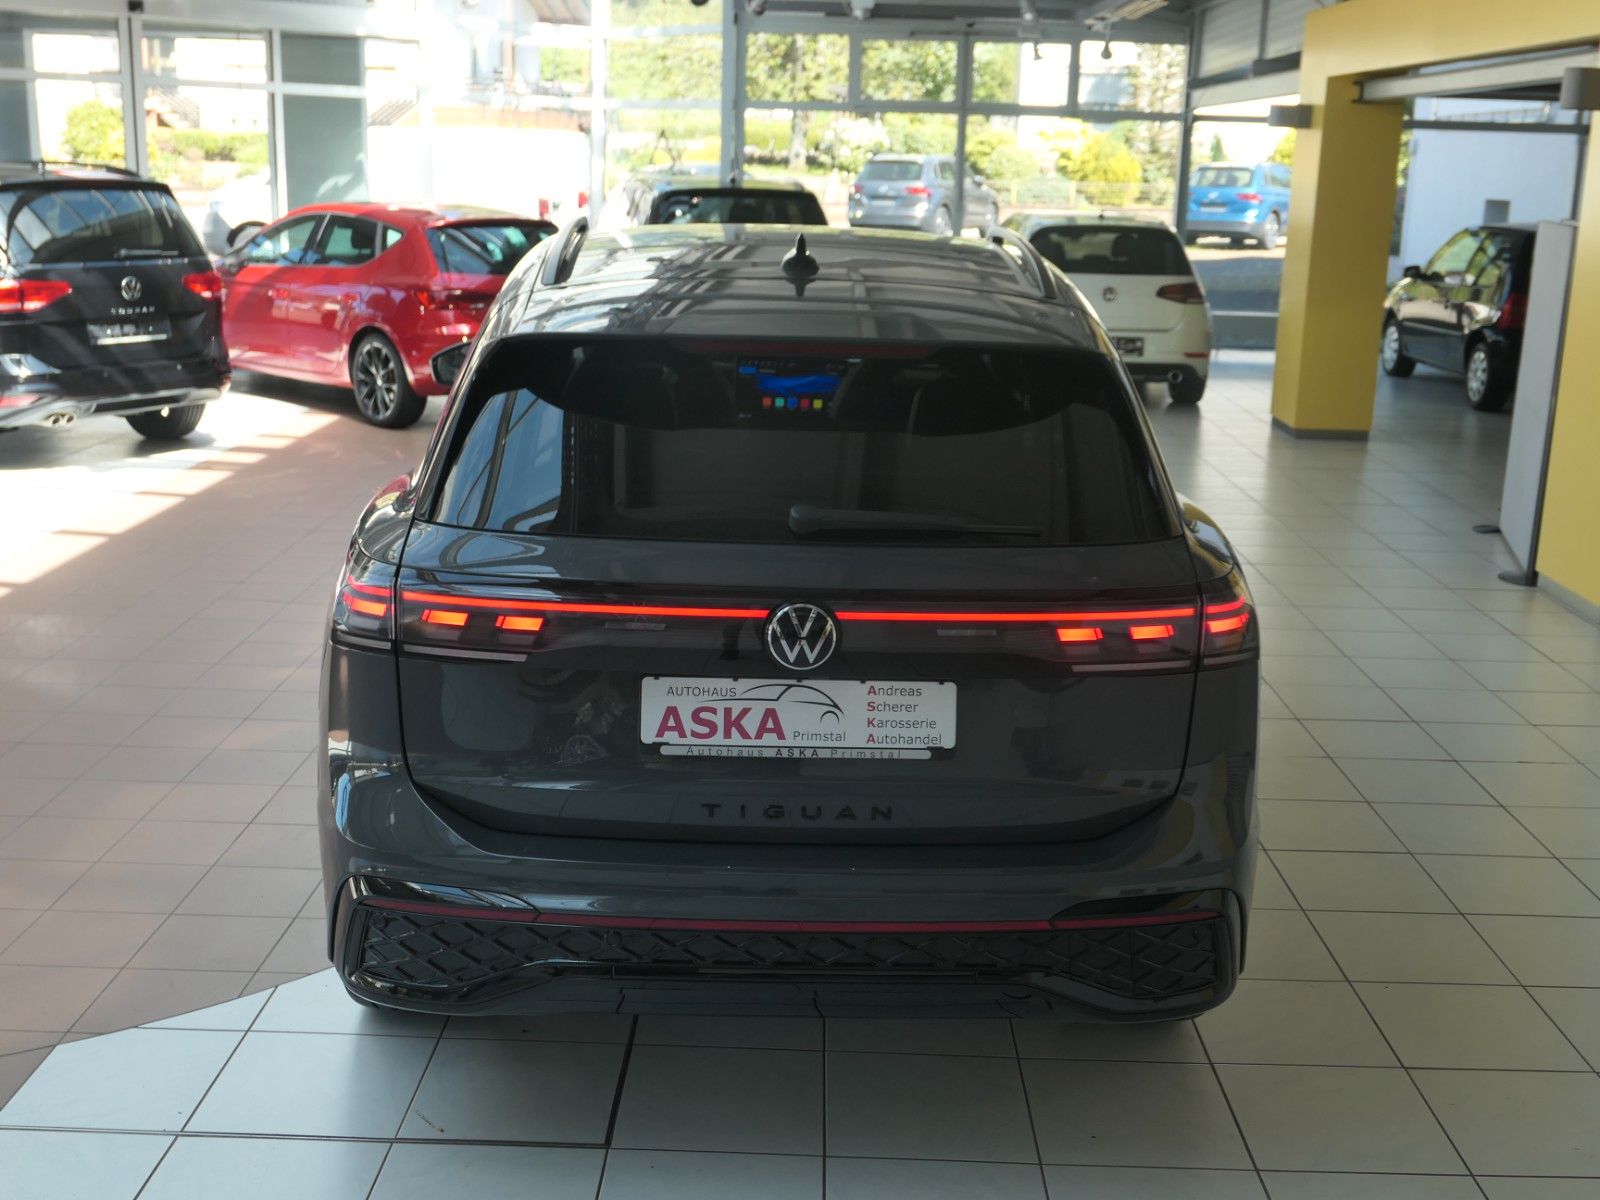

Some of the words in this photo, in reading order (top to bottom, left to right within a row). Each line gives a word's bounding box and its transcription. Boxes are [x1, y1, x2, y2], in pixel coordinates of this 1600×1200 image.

[666, 686, 737, 697] AUTOHAUS
[867, 685, 922, 697] Andreas
[866, 701, 919, 713] Scherer
[655, 705, 786, 740] ASKA
[866, 717, 937, 729] Karosserie
[793, 730, 846, 742] Primstal
[866, 733, 942, 745] Autohandel
[686, 746, 764, 756] Autohaus
[775, 748, 819, 758] ASKA
[830, 749, 901, 759] Primstal
[701, 803, 893, 821] TIGUAN
